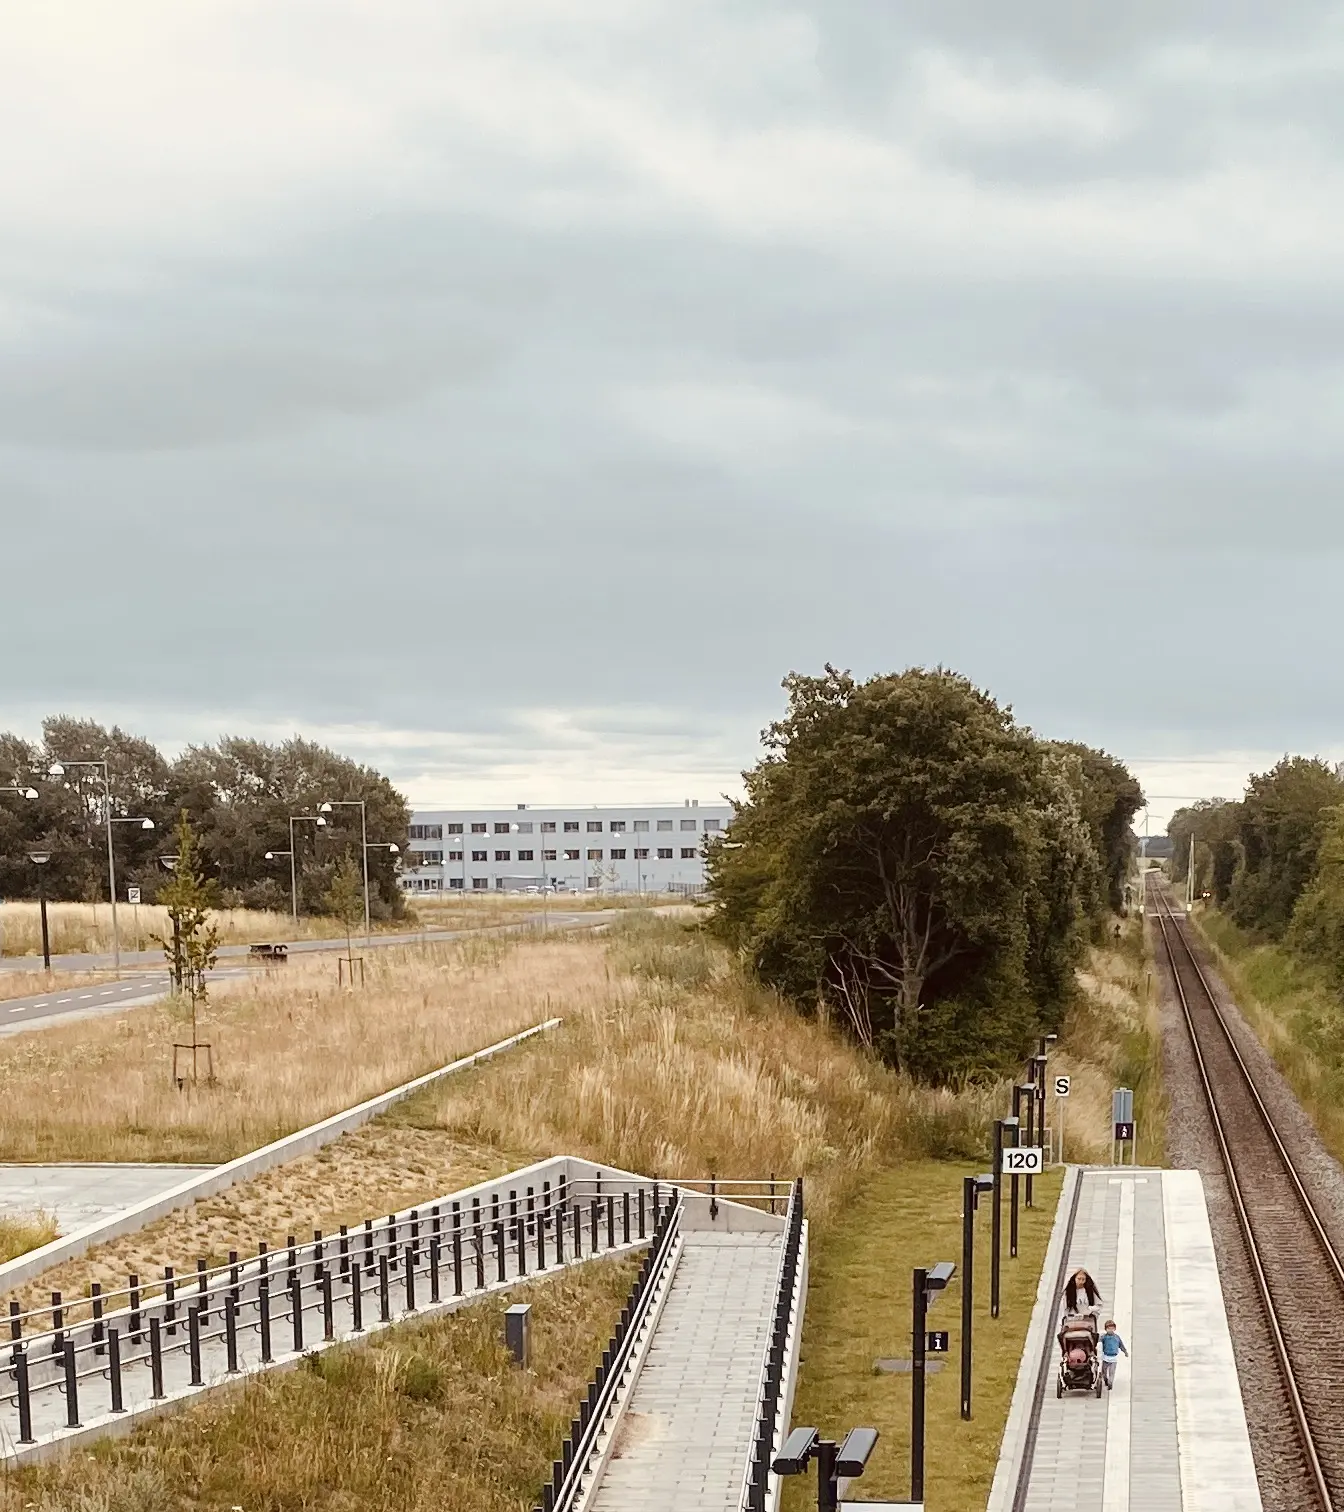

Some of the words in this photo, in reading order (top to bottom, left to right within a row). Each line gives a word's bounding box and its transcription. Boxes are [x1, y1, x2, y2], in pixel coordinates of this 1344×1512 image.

[1056, 1078, 1069, 1094] S
[1007, 1153, 1038, 1169] 120
[934, 1338, 942, 1350] 1
